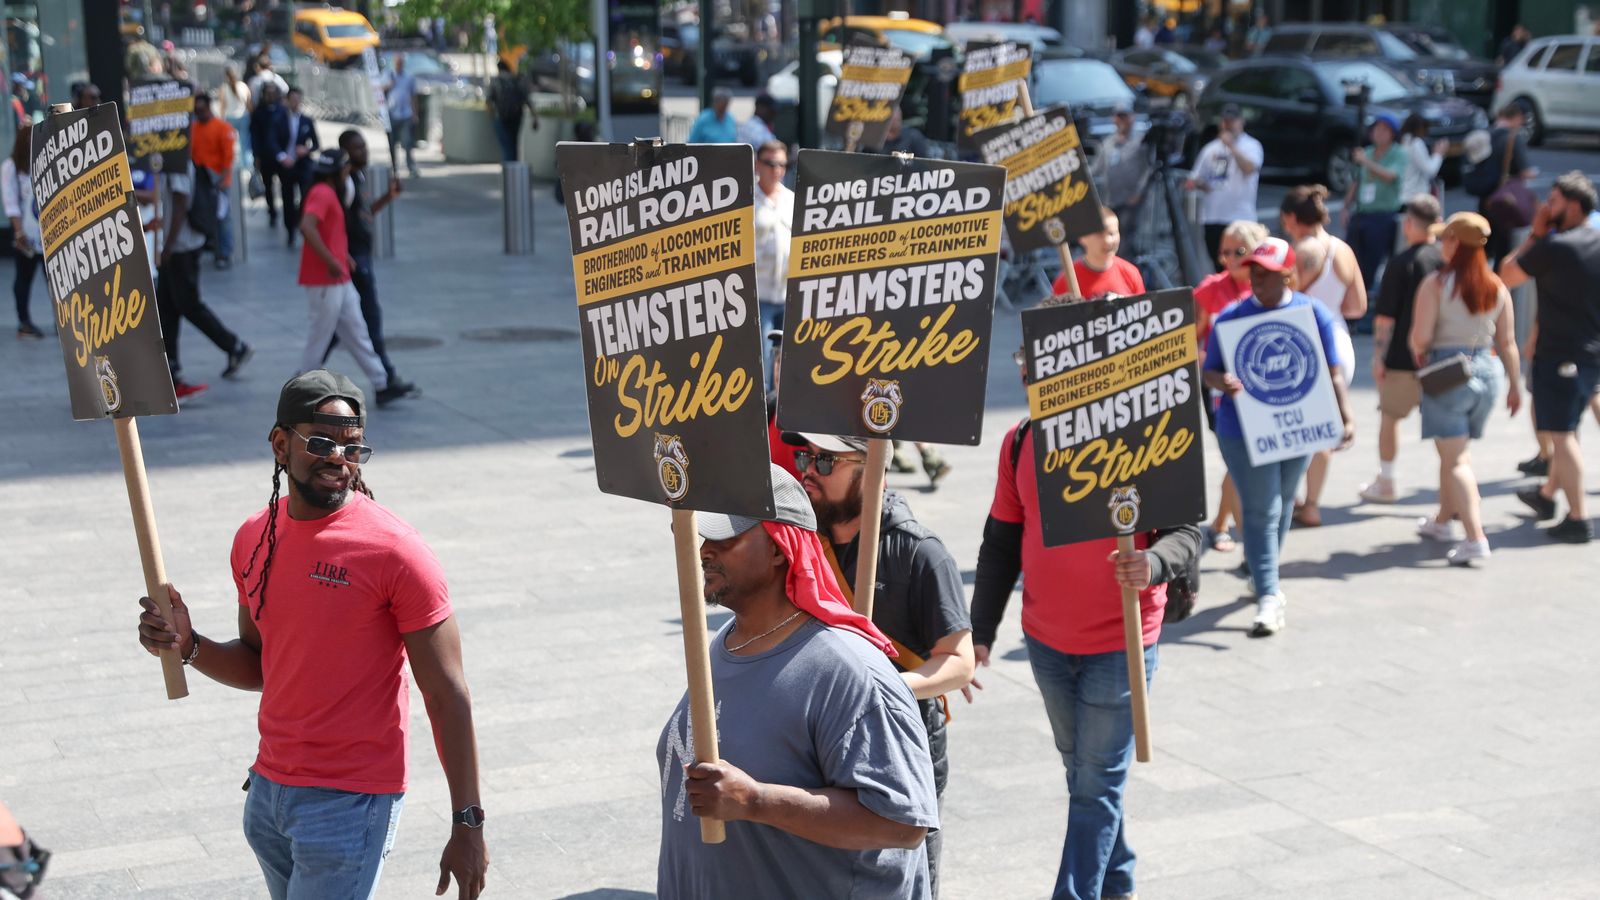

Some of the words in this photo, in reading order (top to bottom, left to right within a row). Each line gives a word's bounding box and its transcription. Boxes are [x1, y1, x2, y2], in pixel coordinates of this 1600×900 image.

[46, 118, 88, 163] ISLAND
[35, 171, 59, 211] RAIL
[56, 130, 114, 186] ROAD
[72, 162, 121, 202] LOCOMOTIVE
[574, 178, 623, 214] LONG
[625, 156, 699, 200] ISLAND
[805, 179, 868, 205] LONG
[872, 168, 955, 197] ISLAND
[76, 182, 124, 220] TRAINMEN
[579, 203, 635, 247] RAIL
[639, 176, 739, 230] ROAD
[803, 201, 883, 232] RAIL
[891, 186, 991, 221] ROAD
[1017, 174, 1089, 230] Strike
[47, 209, 134, 301] TEAMSTERS
[583, 242, 648, 275] BROTHERHOOD
[650, 243, 660, 262] of
[660, 217, 741, 254] LOCOMOTIVE
[800, 247, 887, 270] ENGINEERS
[889, 248, 909, 258] and
[909, 234, 988, 256] TRAINMEN
[802, 230, 896, 254] BROTHERHOOD
[899, 229, 910, 245] of
[910, 218, 990, 240] LOCOMOTIVE
[585, 265, 643, 296] ENGINEERS
[645, 263, 662, 280] and
[662, 240, 741, 275] TRAINMEN
[799, 258, 985, 320] TEAMSTERS
[57, 299, 71, 328] On
[71, 263, 147, 368] Strike
[587, 272, 747, 358] TEAMSTERS
[794, 317, 832, 344] On
[811, 303, 980, 385] Strike
[1033, 325, 1085, 358] LONG
[1087, 299, 1153, 339] ISLAND
[1035, 340, 1103, 380] RAIL
[1107, 307, 1184, 355] ROAD
[594, 354, 620, 387] On
[614, 334, 753, 438] Strike
[1039, 362, 1116, 398] BROTHERHOOD
[1118, 357, 1127, 372] of
[1126, 332, 1187, 367] LOCOMOTIVE
[1040, 377, 1110, 412] ENGINEERS
[1127, 347, 1187, 381] TRAINMEN
[1041, 367, 1191, 453] TEAMSTERS
[1256, 433, 1279, 453] ON
[1282, 421, 1337, 448] STRIKE
[1273, 409, 1304, 429] TCU
[1043, 448, 1075, 473] On
[1062, 410, 1195, 503] Strike
[314, 561, 348, 581] LIRR
